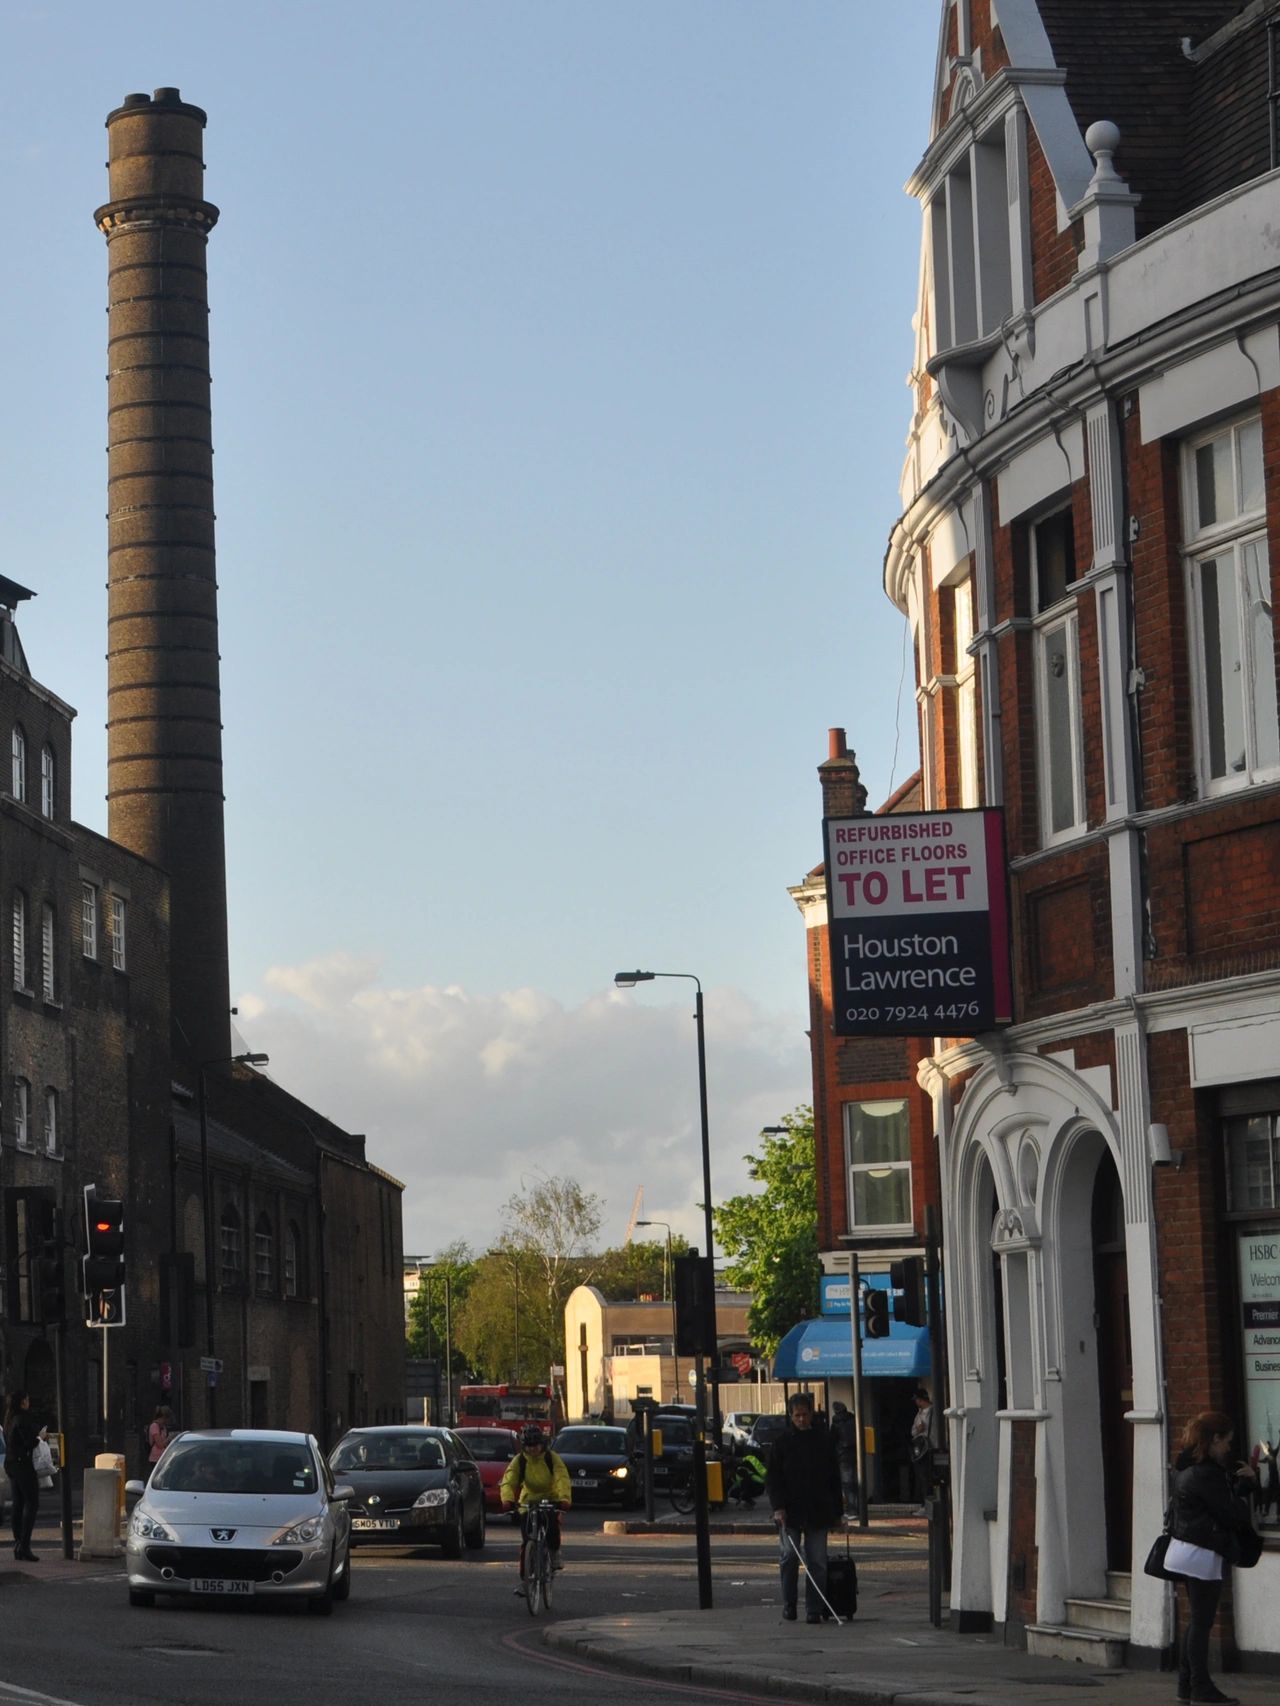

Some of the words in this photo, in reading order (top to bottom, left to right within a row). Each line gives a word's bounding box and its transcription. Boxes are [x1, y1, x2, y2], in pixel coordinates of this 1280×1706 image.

[836, 821, 953, 843] REFURBISHED
[837, 848, 896, 866] OFFICE
[901, 844, 968, 862] FLOORS
[838, 871, 889, 906] TO
[902, 866, 971, 903] LET
[843, 934, 958, 959] Houston
[845, 966, 977, 991] Lawrence
[846, 1008, 880, 1021] 020
[886, 1004, 929, 1022] 7924
[934, 1001, 979, 1020] 4476
[1249, 1244, 1278, 1261] HSBC
[1252, 1308, 1279, 1321] Premier
[354, 1519, 376, 1528] SM05
[379, 1519, 396, 1528] VTU
[194, 1580, 224, 1593] LD55
[227, 1581, 250, 1593] JXN
